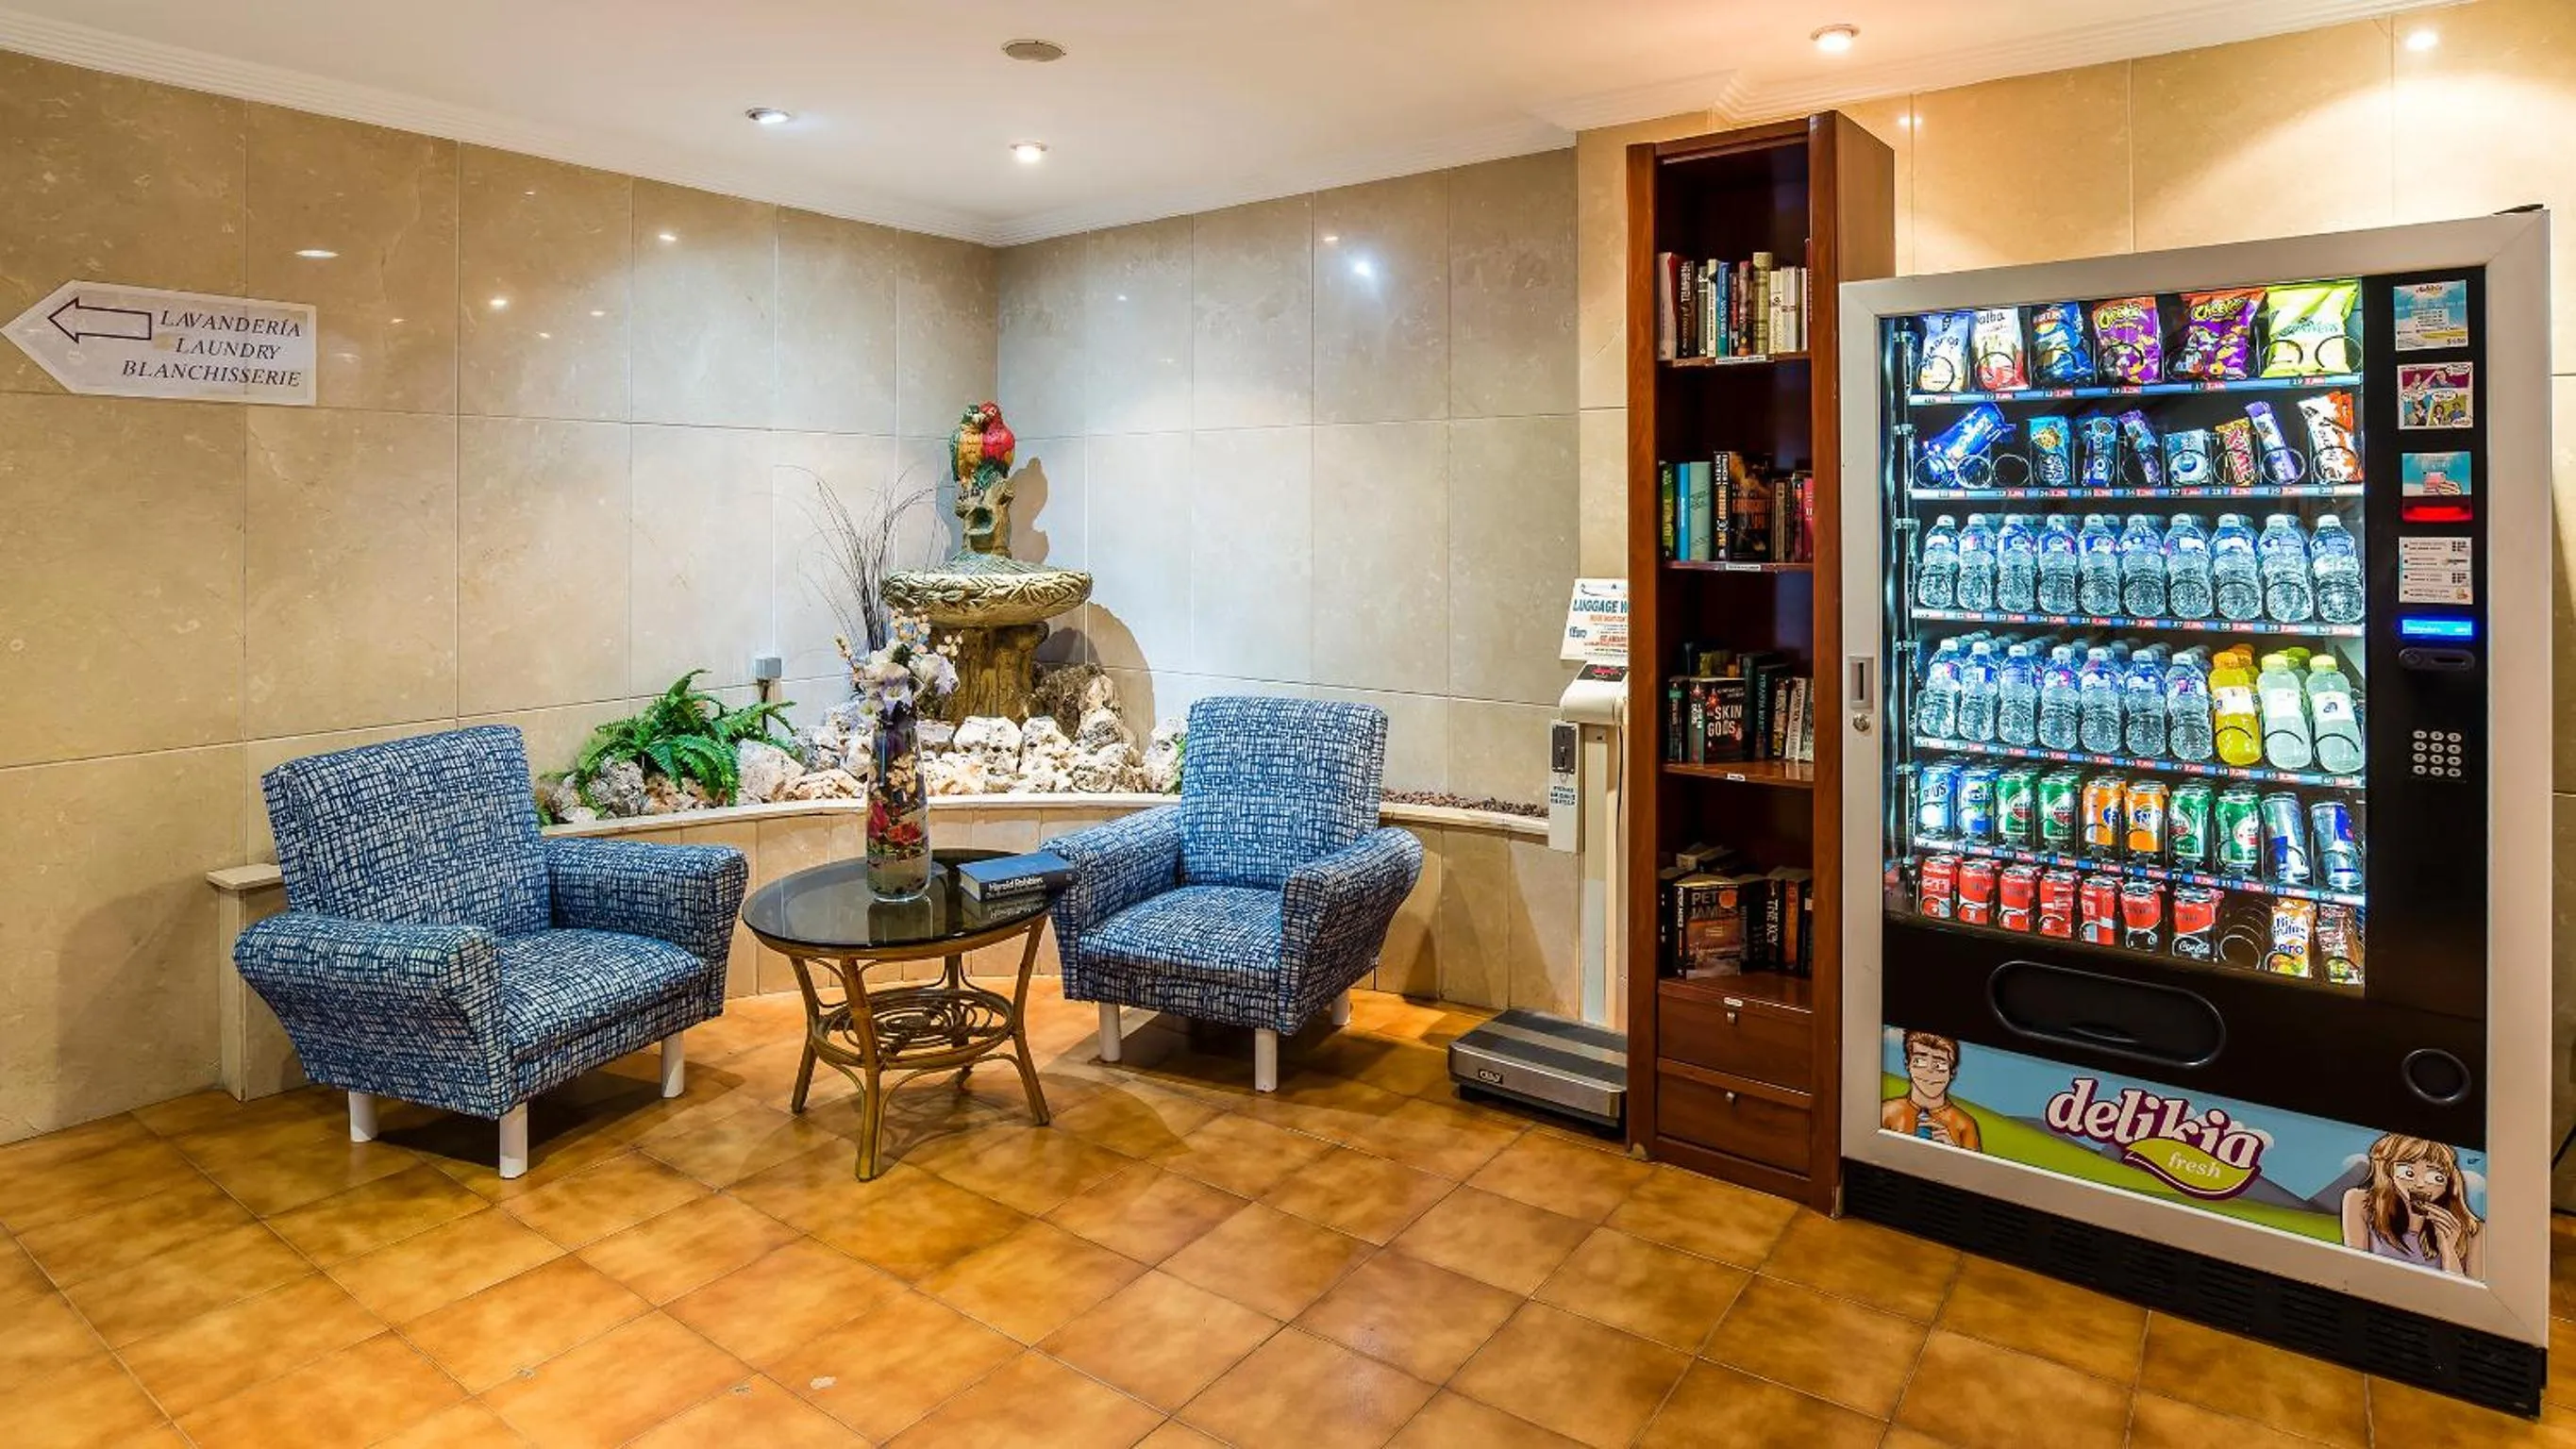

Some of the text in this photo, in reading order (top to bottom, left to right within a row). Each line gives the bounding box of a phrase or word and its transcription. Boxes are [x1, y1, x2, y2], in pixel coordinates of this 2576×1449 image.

[160, 310, 302, 338] LAVANDERÍA
[176, 337, 281, 360] LAUNDRY
[123, 360, 301, 388] BLANCHISSERIE
[1573, 598, 1618, 614] LUGGAGE
[1715, 705, 1743, 721] SKIN
[2045, 1077, 2266, 1170] delikia
[2167, 1151, 2221, 1178] fresh
